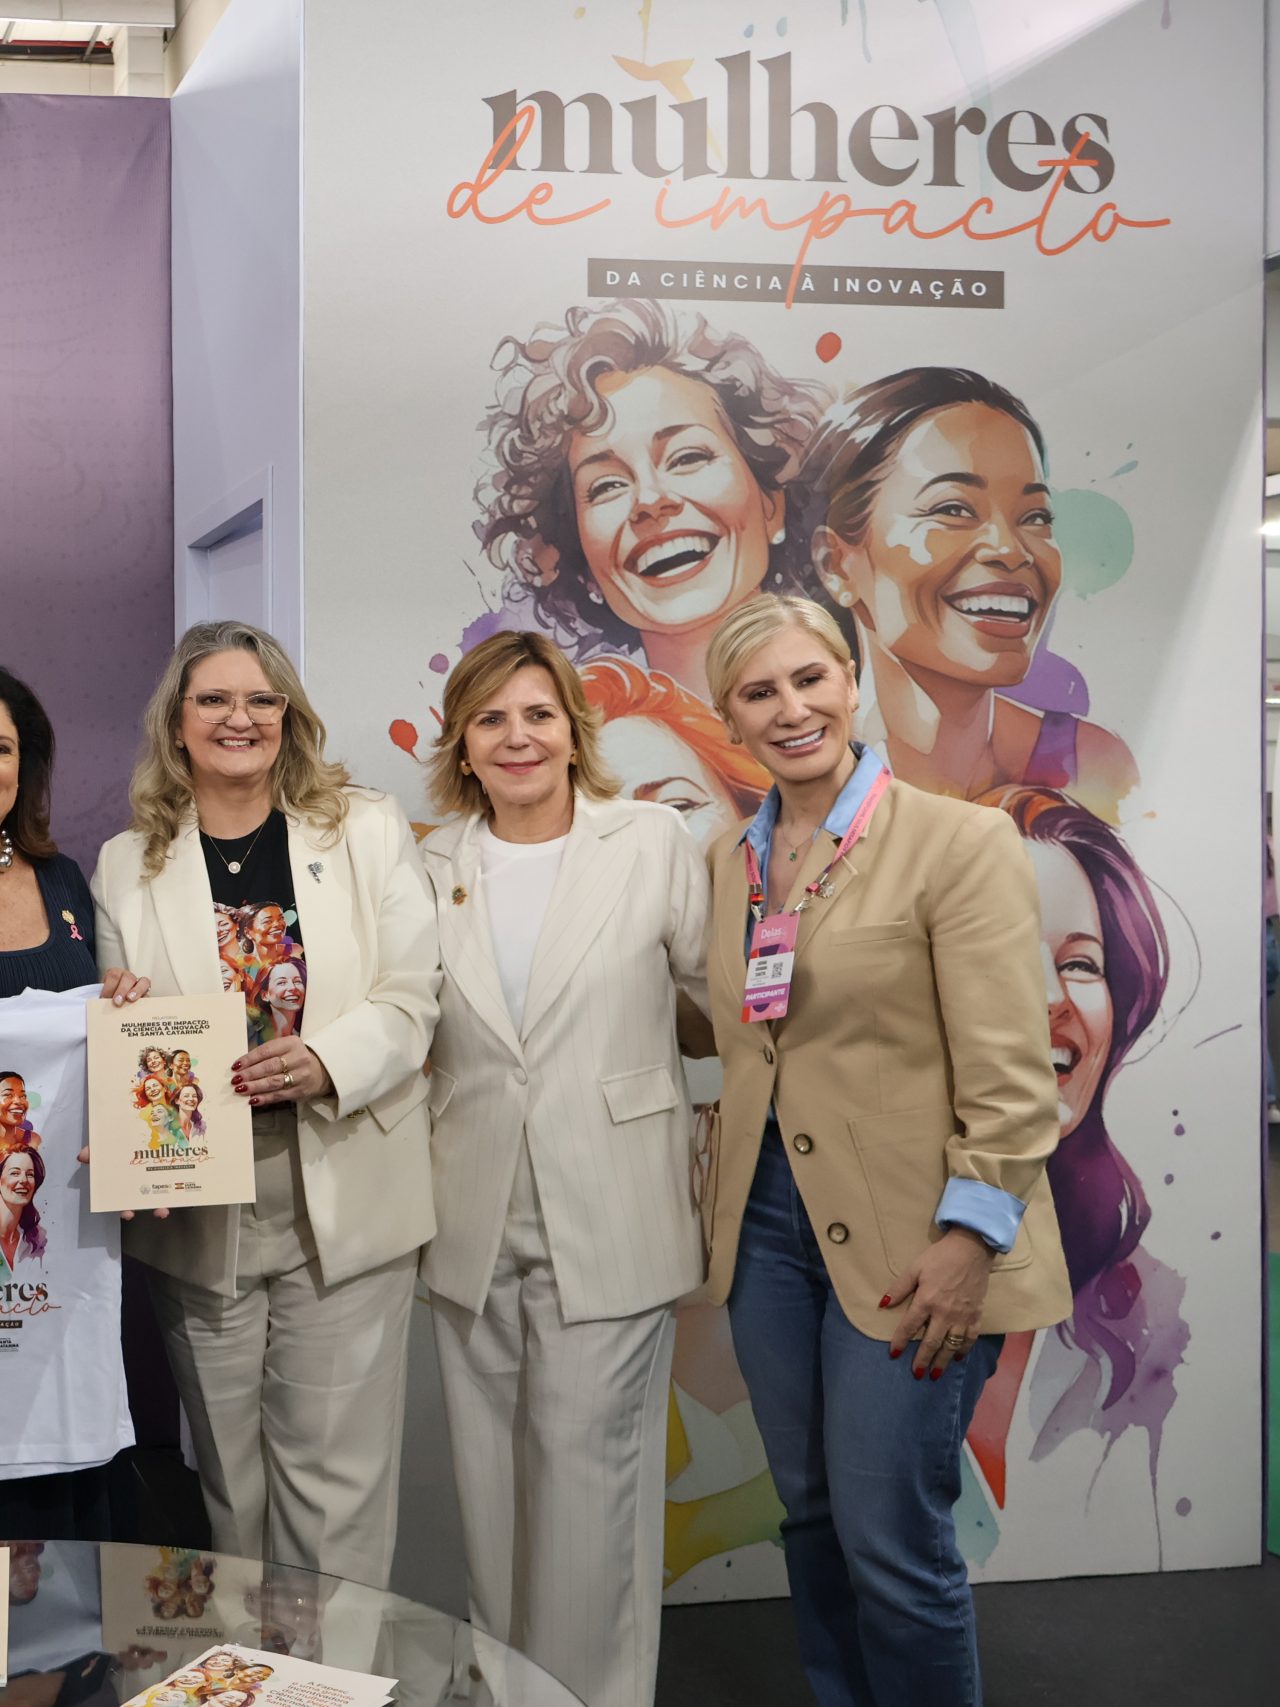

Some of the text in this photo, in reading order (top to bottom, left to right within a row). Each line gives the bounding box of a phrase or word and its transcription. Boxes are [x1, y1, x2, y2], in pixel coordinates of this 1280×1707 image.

[481, 51, 1115, 194] mulheres
[446, 105, 1171, 309] de impacto
[606, 270, 987, 300] DA CIÊNCIA À INOVAÇÃO
[745, 988, 785, 1000] PARTICIPANTE
[134, 1143, 209, 1160] mulheres
